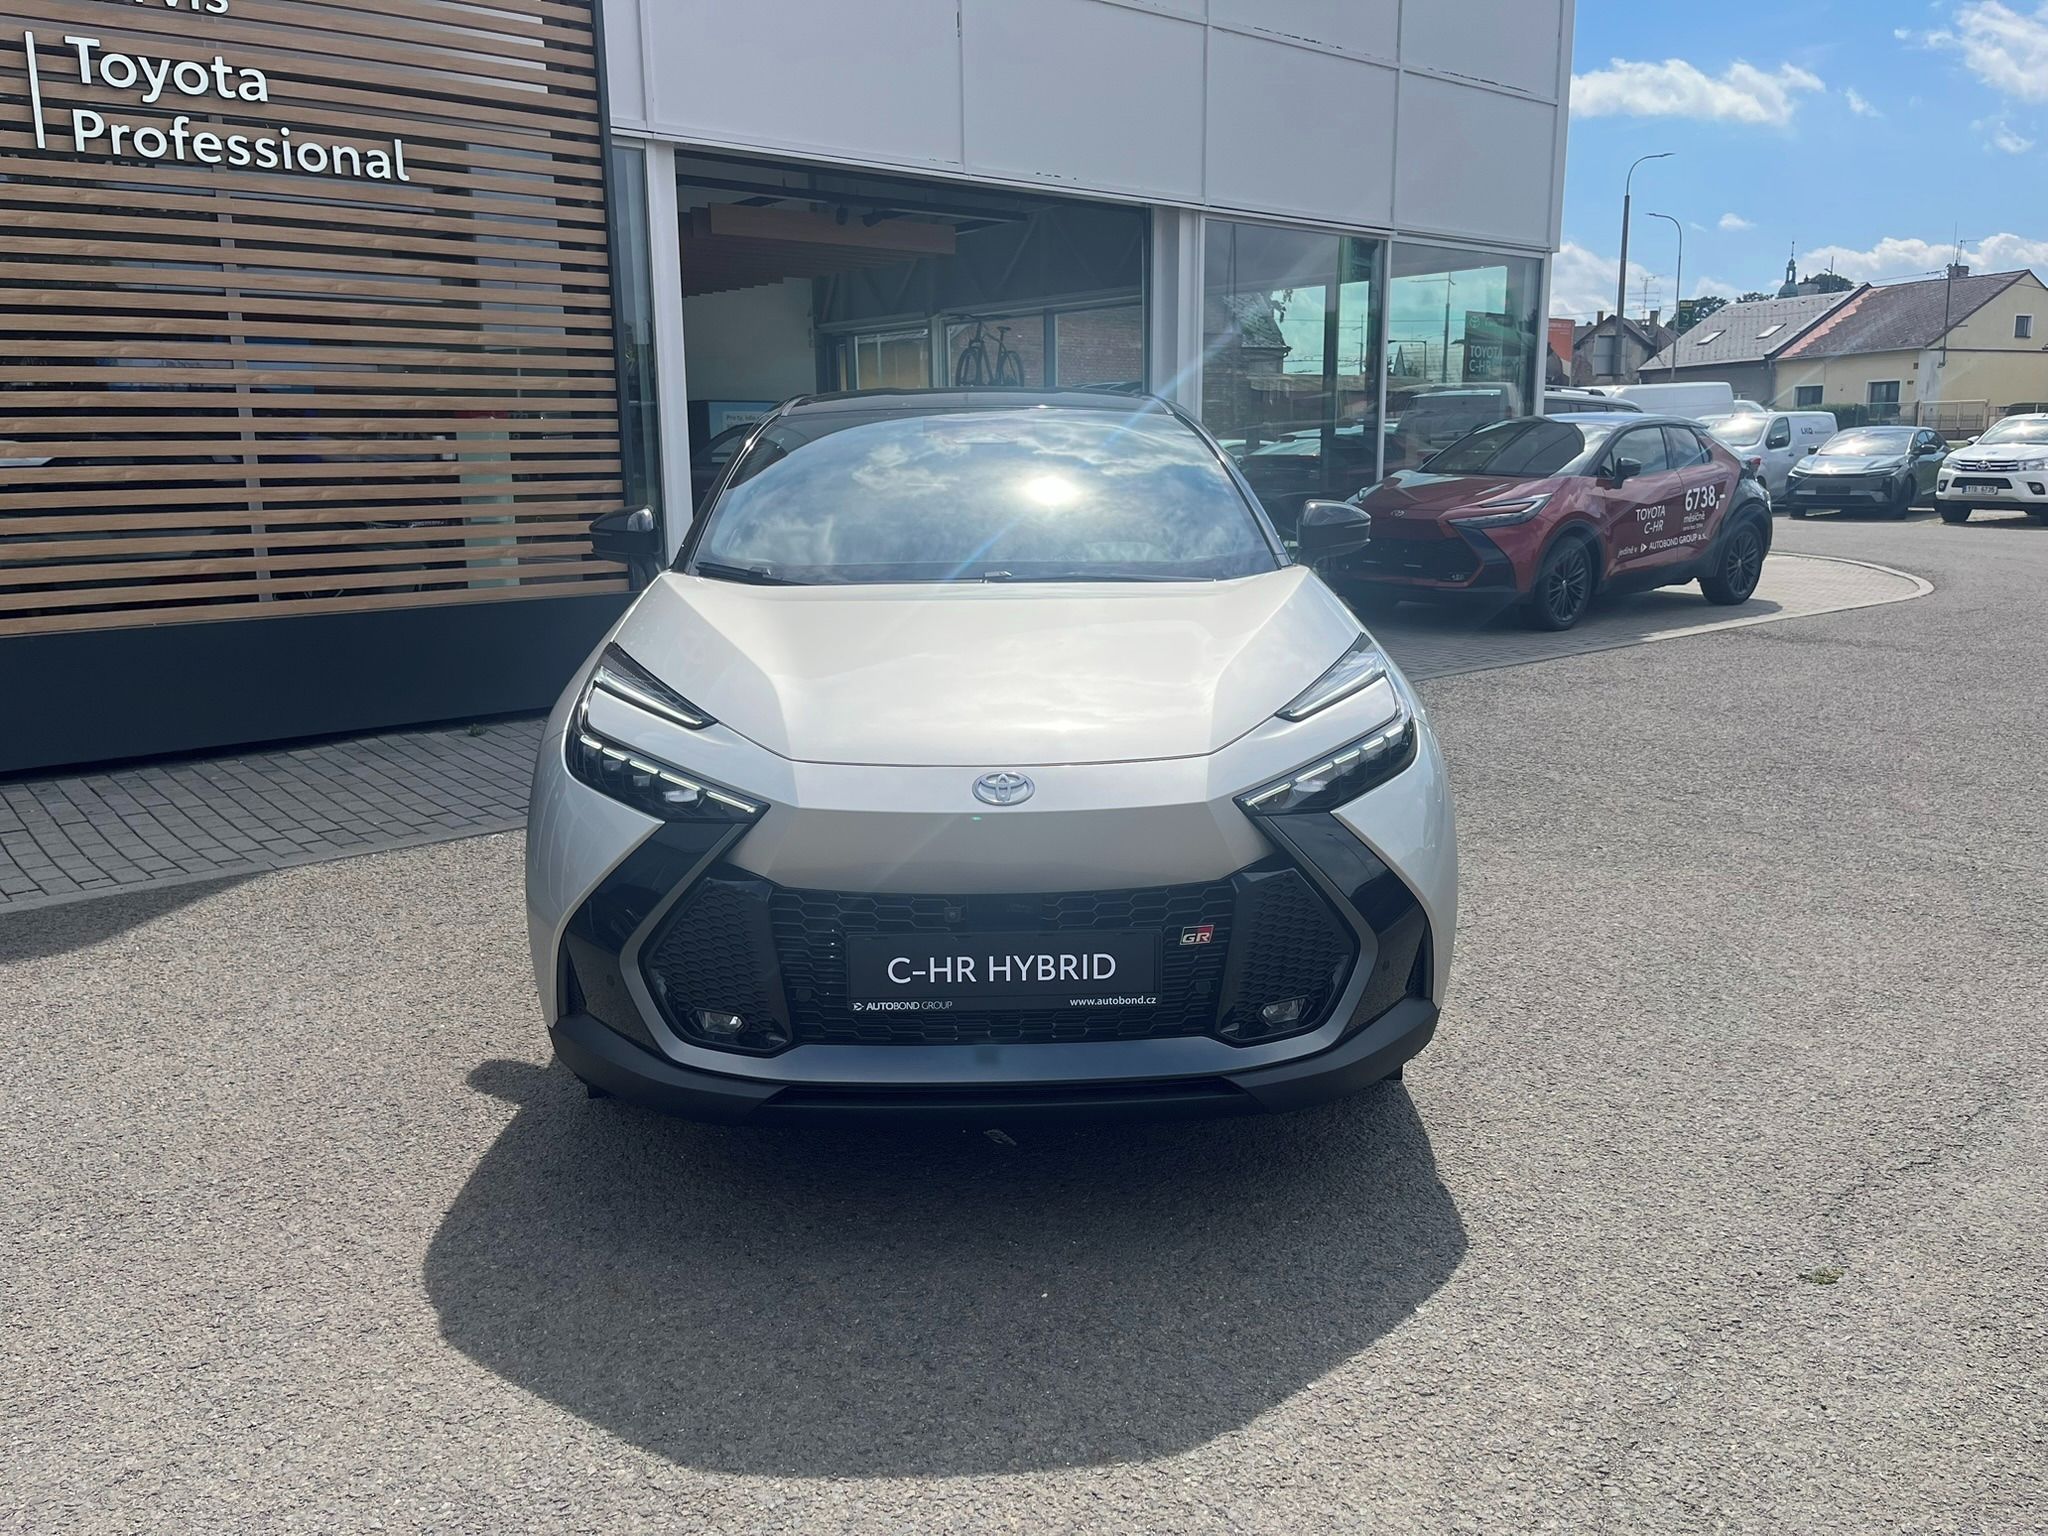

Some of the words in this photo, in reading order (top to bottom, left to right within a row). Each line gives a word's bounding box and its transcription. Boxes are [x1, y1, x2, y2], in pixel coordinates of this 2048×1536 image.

[64, 35, 268, 103] Toyota
[72, 108, 410, 182] Professional
[1685, 485, 1725, 511] 6738,-
[1635, 505, 1666, 522] TOYOTA
[1643, 519, 1664, 534] C-HR
[1649, 537, 1679, 551] AUTOBOND
[1679, 533, 1698, 545] GROUP
[1182, 931, 1211, 943] GR
[887, 956, 977, 984] C-HR
[988, 953, 1116, 982] HYBRID
[866, 1001, 920, 1011] AUTOBOND
[921, 1001, 953, 1010] GROUP
[1069, 995, 1157, 1006] www.autobond.cz
